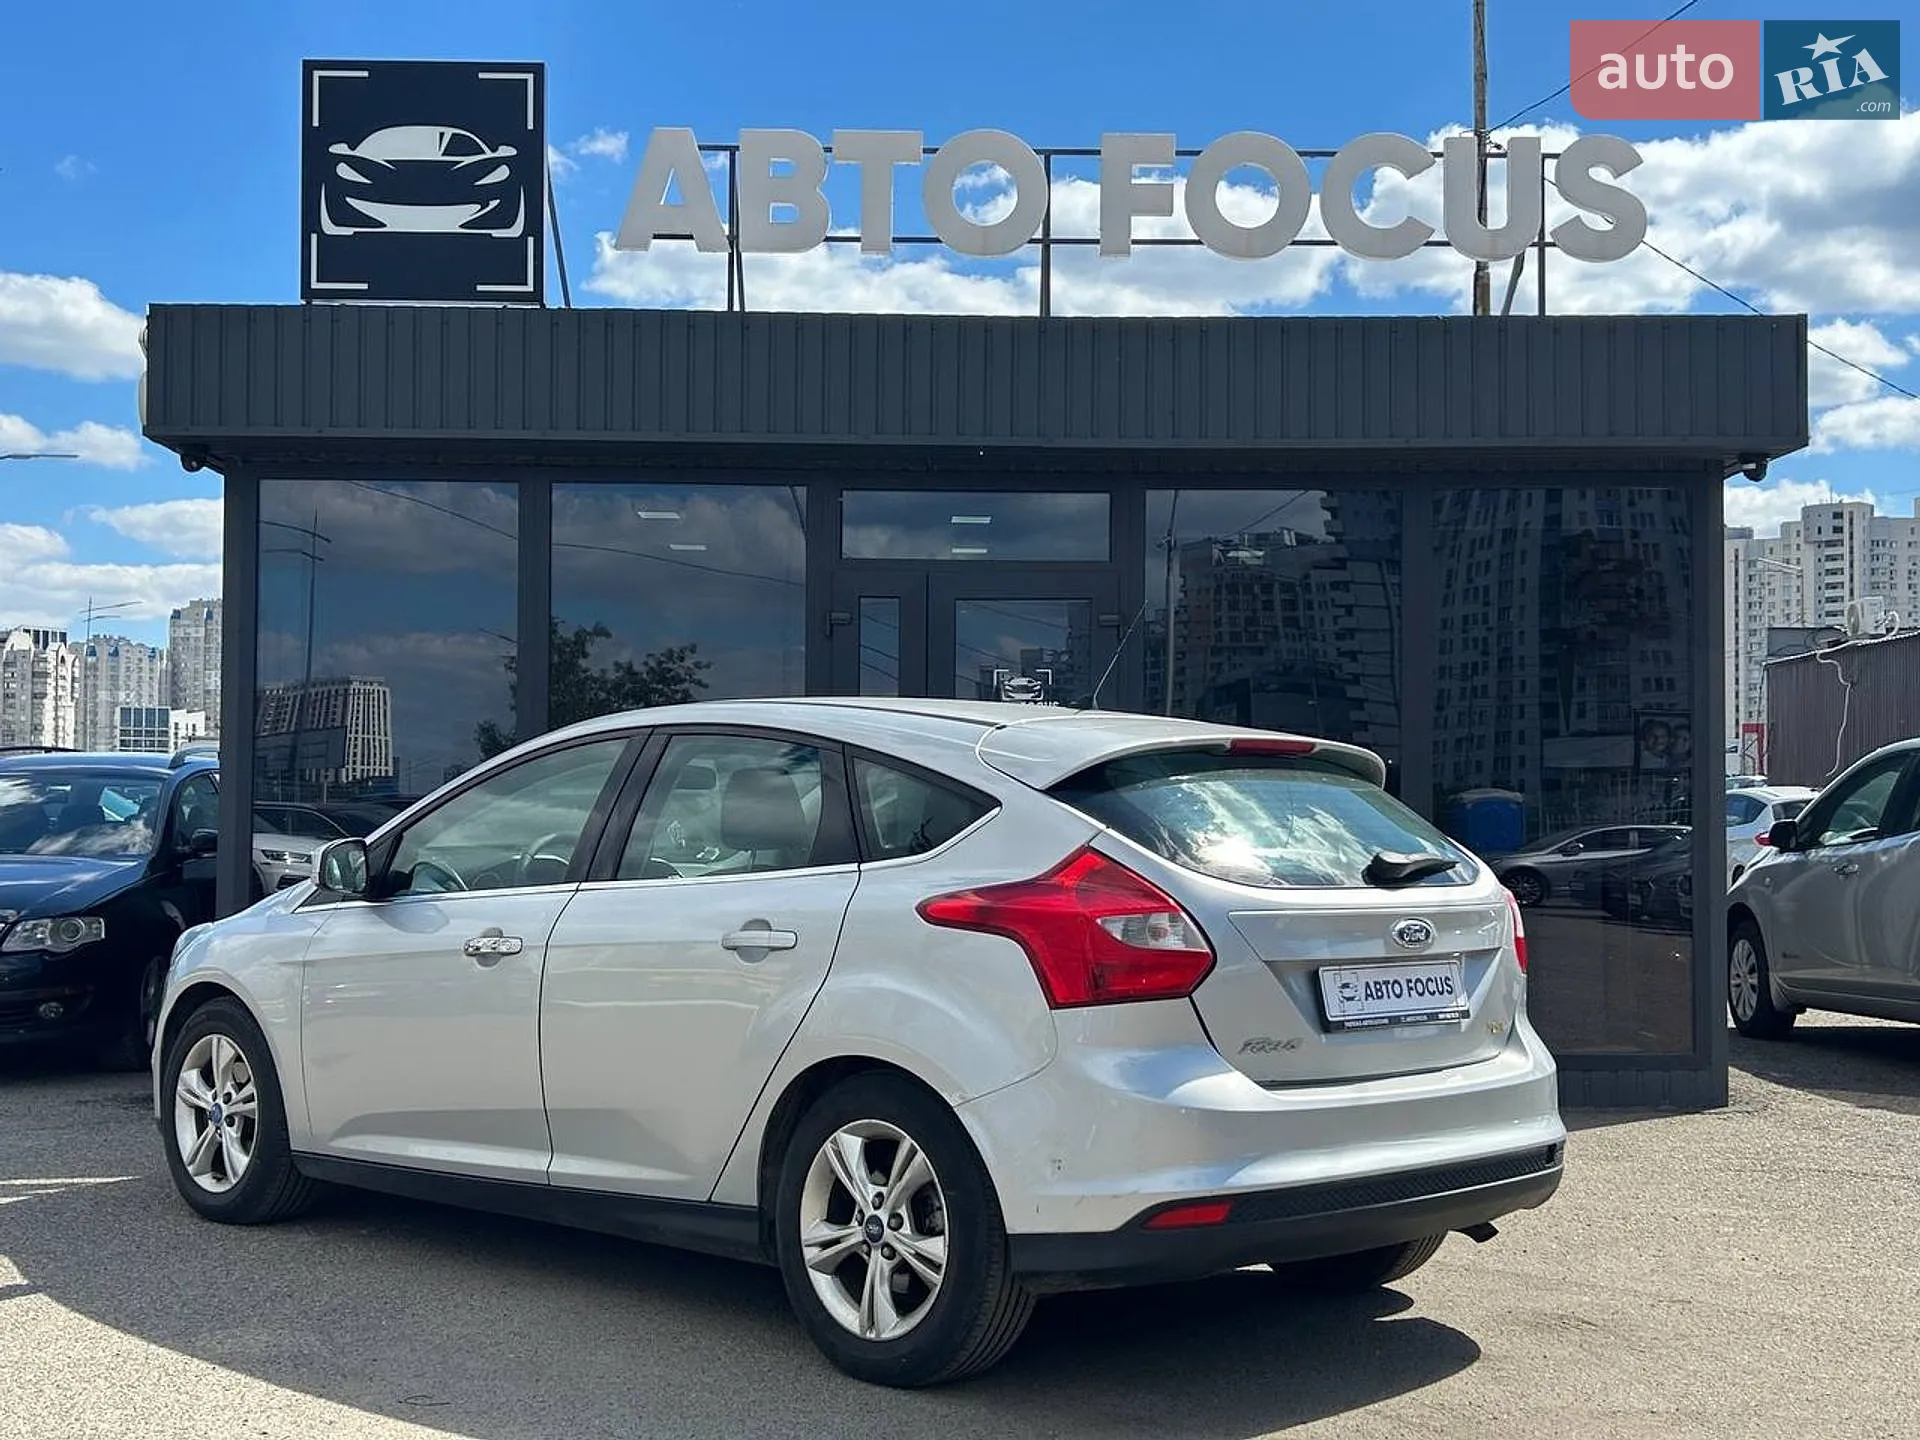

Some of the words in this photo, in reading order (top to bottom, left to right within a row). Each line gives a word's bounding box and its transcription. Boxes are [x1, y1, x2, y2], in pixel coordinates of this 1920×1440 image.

[616, 127, 1049, 256] АВТО
[1100, 132, 1646, 261] FOCUS
[1364, 979, 1403, 1001] АВТО
[1406, 976, 1453, 997] FOCUS
